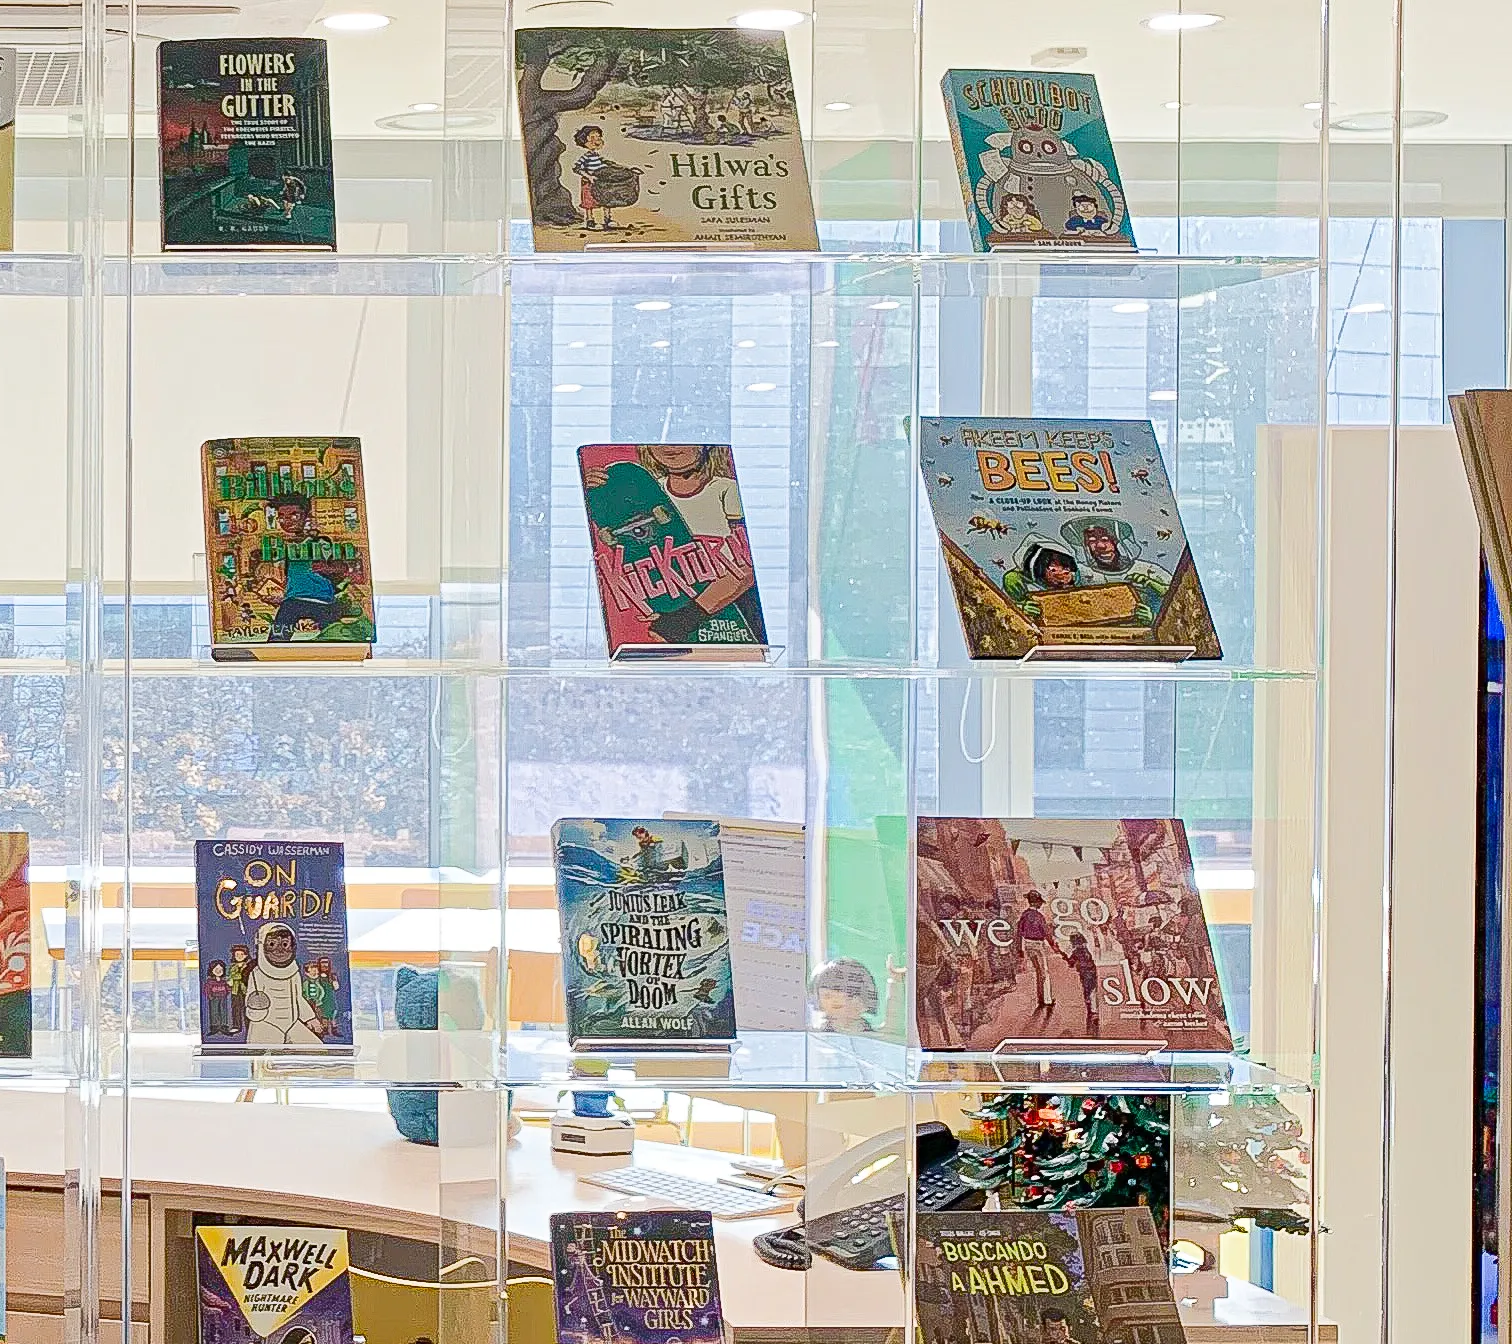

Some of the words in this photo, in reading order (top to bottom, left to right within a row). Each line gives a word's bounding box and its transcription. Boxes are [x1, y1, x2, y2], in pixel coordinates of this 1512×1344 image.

[219, 53, 295, 76] FLOWERS
[241, 78, 252, 92] IN
[257, 78, 278, 92] THE
[963, 77, 1091, 114] SCHOOLBOT
[221, 94, 296, 117] GUTTER
[670, 152, 788, 178] Hilwa's
[692, 185, 777, 210] Gifts
[961, 428, 1039, 449] AKEEM
[1045, 431, 1114, 450] KEEPS
[976, 449, 1120, 494] BEES!
[698, 629, 754, 642] SPANGLER
[213, 843, 263, 856] CASSIDY
[268, 846, 330, 856] WASSERMAN
[244, 859, 296, 887] ON
[216, 877, 333, 920] GUARD!
[653, 891, 687, 914] LEAK
[629, 915, 649, 924] AND
[651, 916, 670, 926] THE
[1050, 897, 1109, 938] go
[600, 918, 701, 951] SPIRALING
[940, 919, 1014, 947] we
[616, 947, 688, 979] VORTEX
[628, 979, 678, 1009] DOOM
[1103, 959, 1215, 1006] slow
[621, 1016, 658, 1029] ALLAN
[661, 1017, 693, 1029] WOLF
[221, 1236, 338, 1269] MAXWELL
[593, 1240, 713, 1266] MIDWATCH
[942, 1241, 1048, 1262] BUSCANDO
[243, 1261, 320, 1293] DARK
[952, 1272, 965, 1292] A
[969, 1264, 1069, 1296] AHMED
[244, 1294, 299, 1305] NIGHTMARE
[251, 1304, 288, 1313] HUNTER
[623, 1288, 709, 1309] WAYWARD
[644, 1310, 694, 1330] GIRLS
